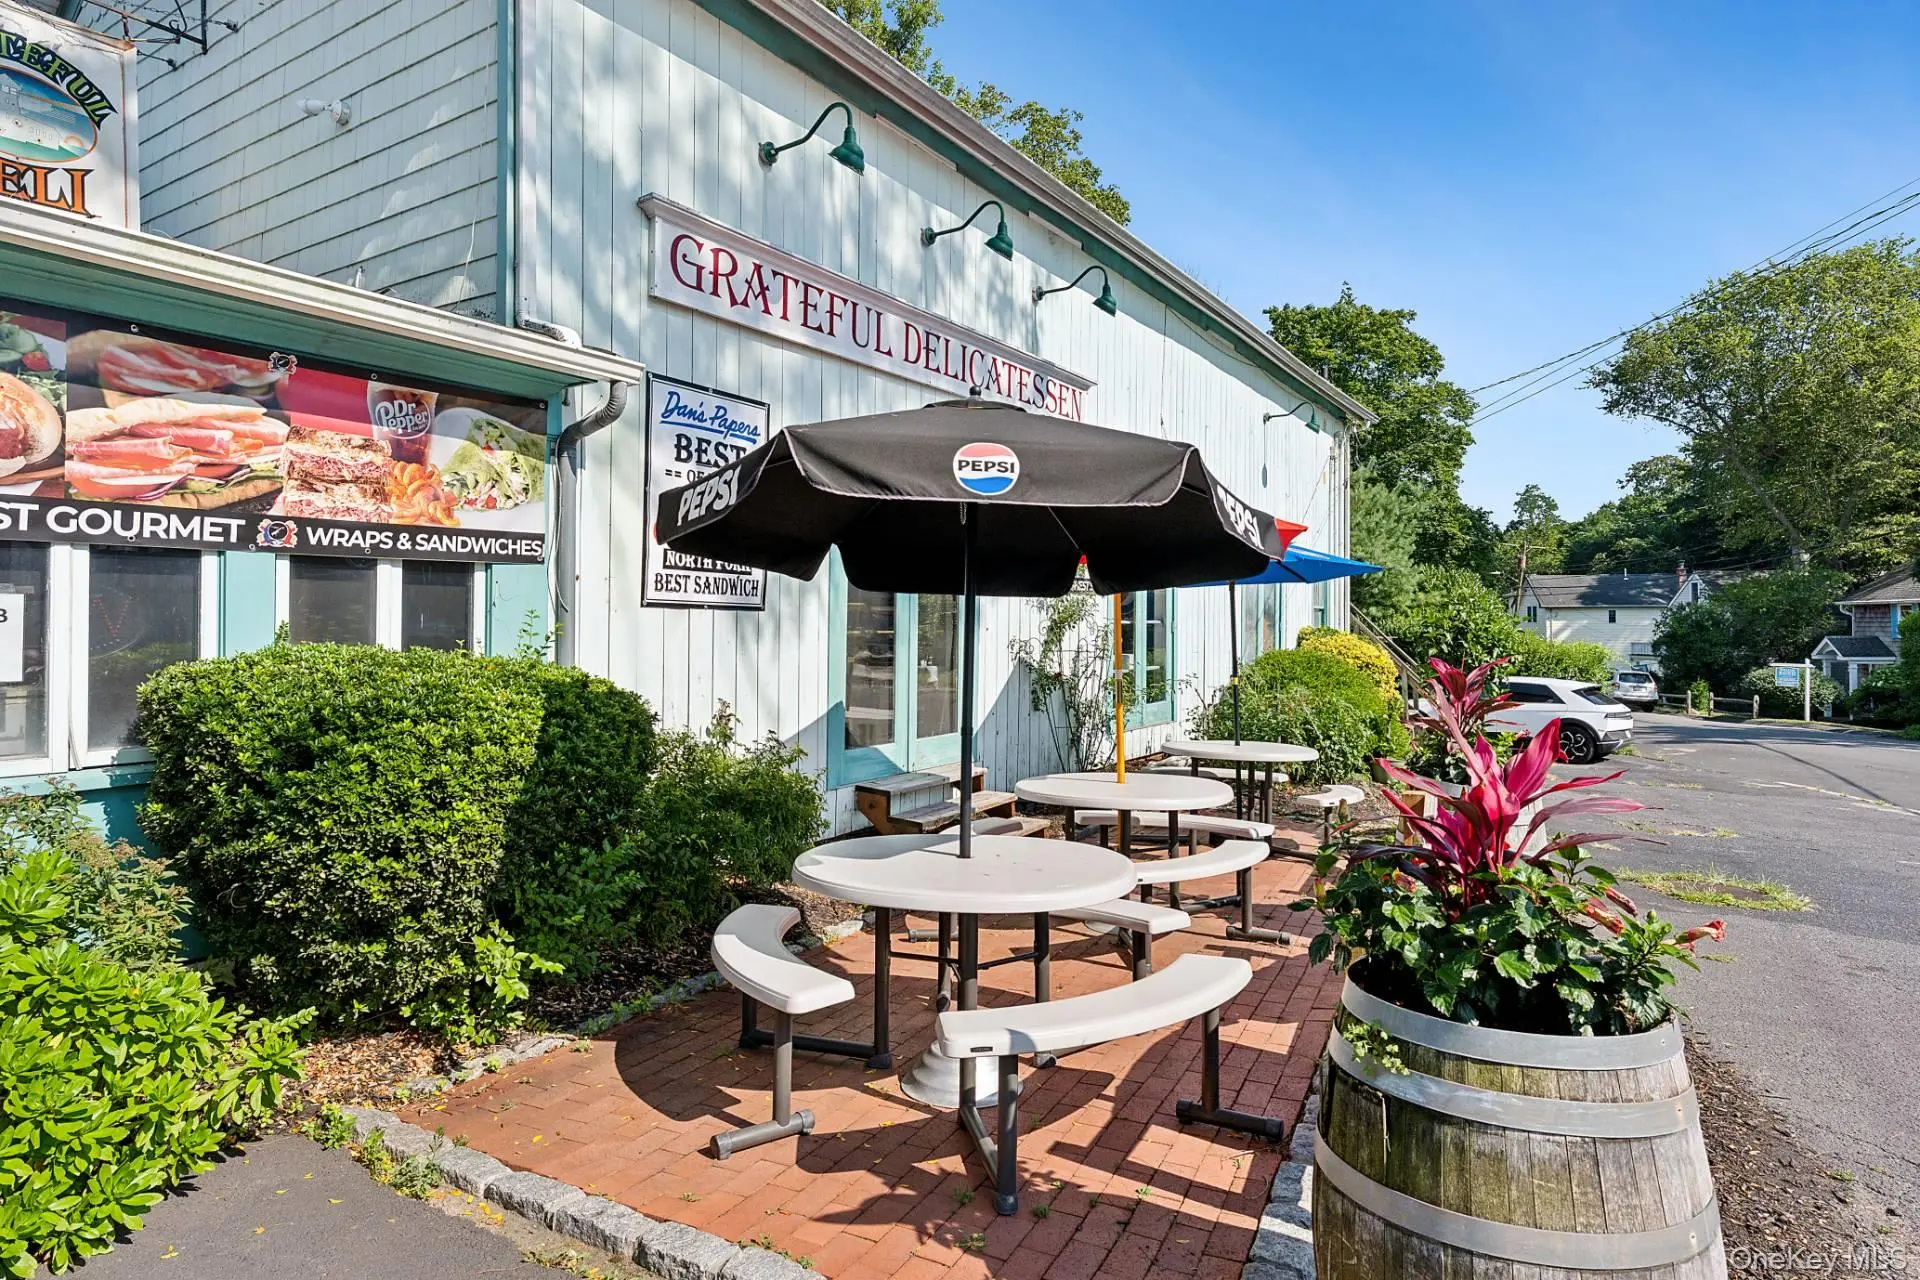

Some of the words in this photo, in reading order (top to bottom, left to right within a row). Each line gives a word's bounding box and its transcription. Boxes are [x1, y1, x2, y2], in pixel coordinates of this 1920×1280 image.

[670, 233, 893, 357] GRATEFUL
[903, 321, 1083, 423] DELICATESSEN
[375, 402, 428, 434] Pepper
[394, 400, 416, 418] Dr
[660, 391, 707, 422] Dan's
[709, 405, 761, 439] Papers
[674, 433, 747, 468] BEST
[957, 459, 1015, 474] PEPSI
[676, 464, 742, 526] PEPSI
[46, 505, 246, 543] GOURMET
[1217, 484, 1265, 550] PEPSI
[306, 526, 393, 550] WRAPS
[396, 533, 412, 550] &
[415, 533, 543, 557] SANDWICHES
[654, 572, 690, 593] BEST
[694, 575, 759, 597] SANDWICH
